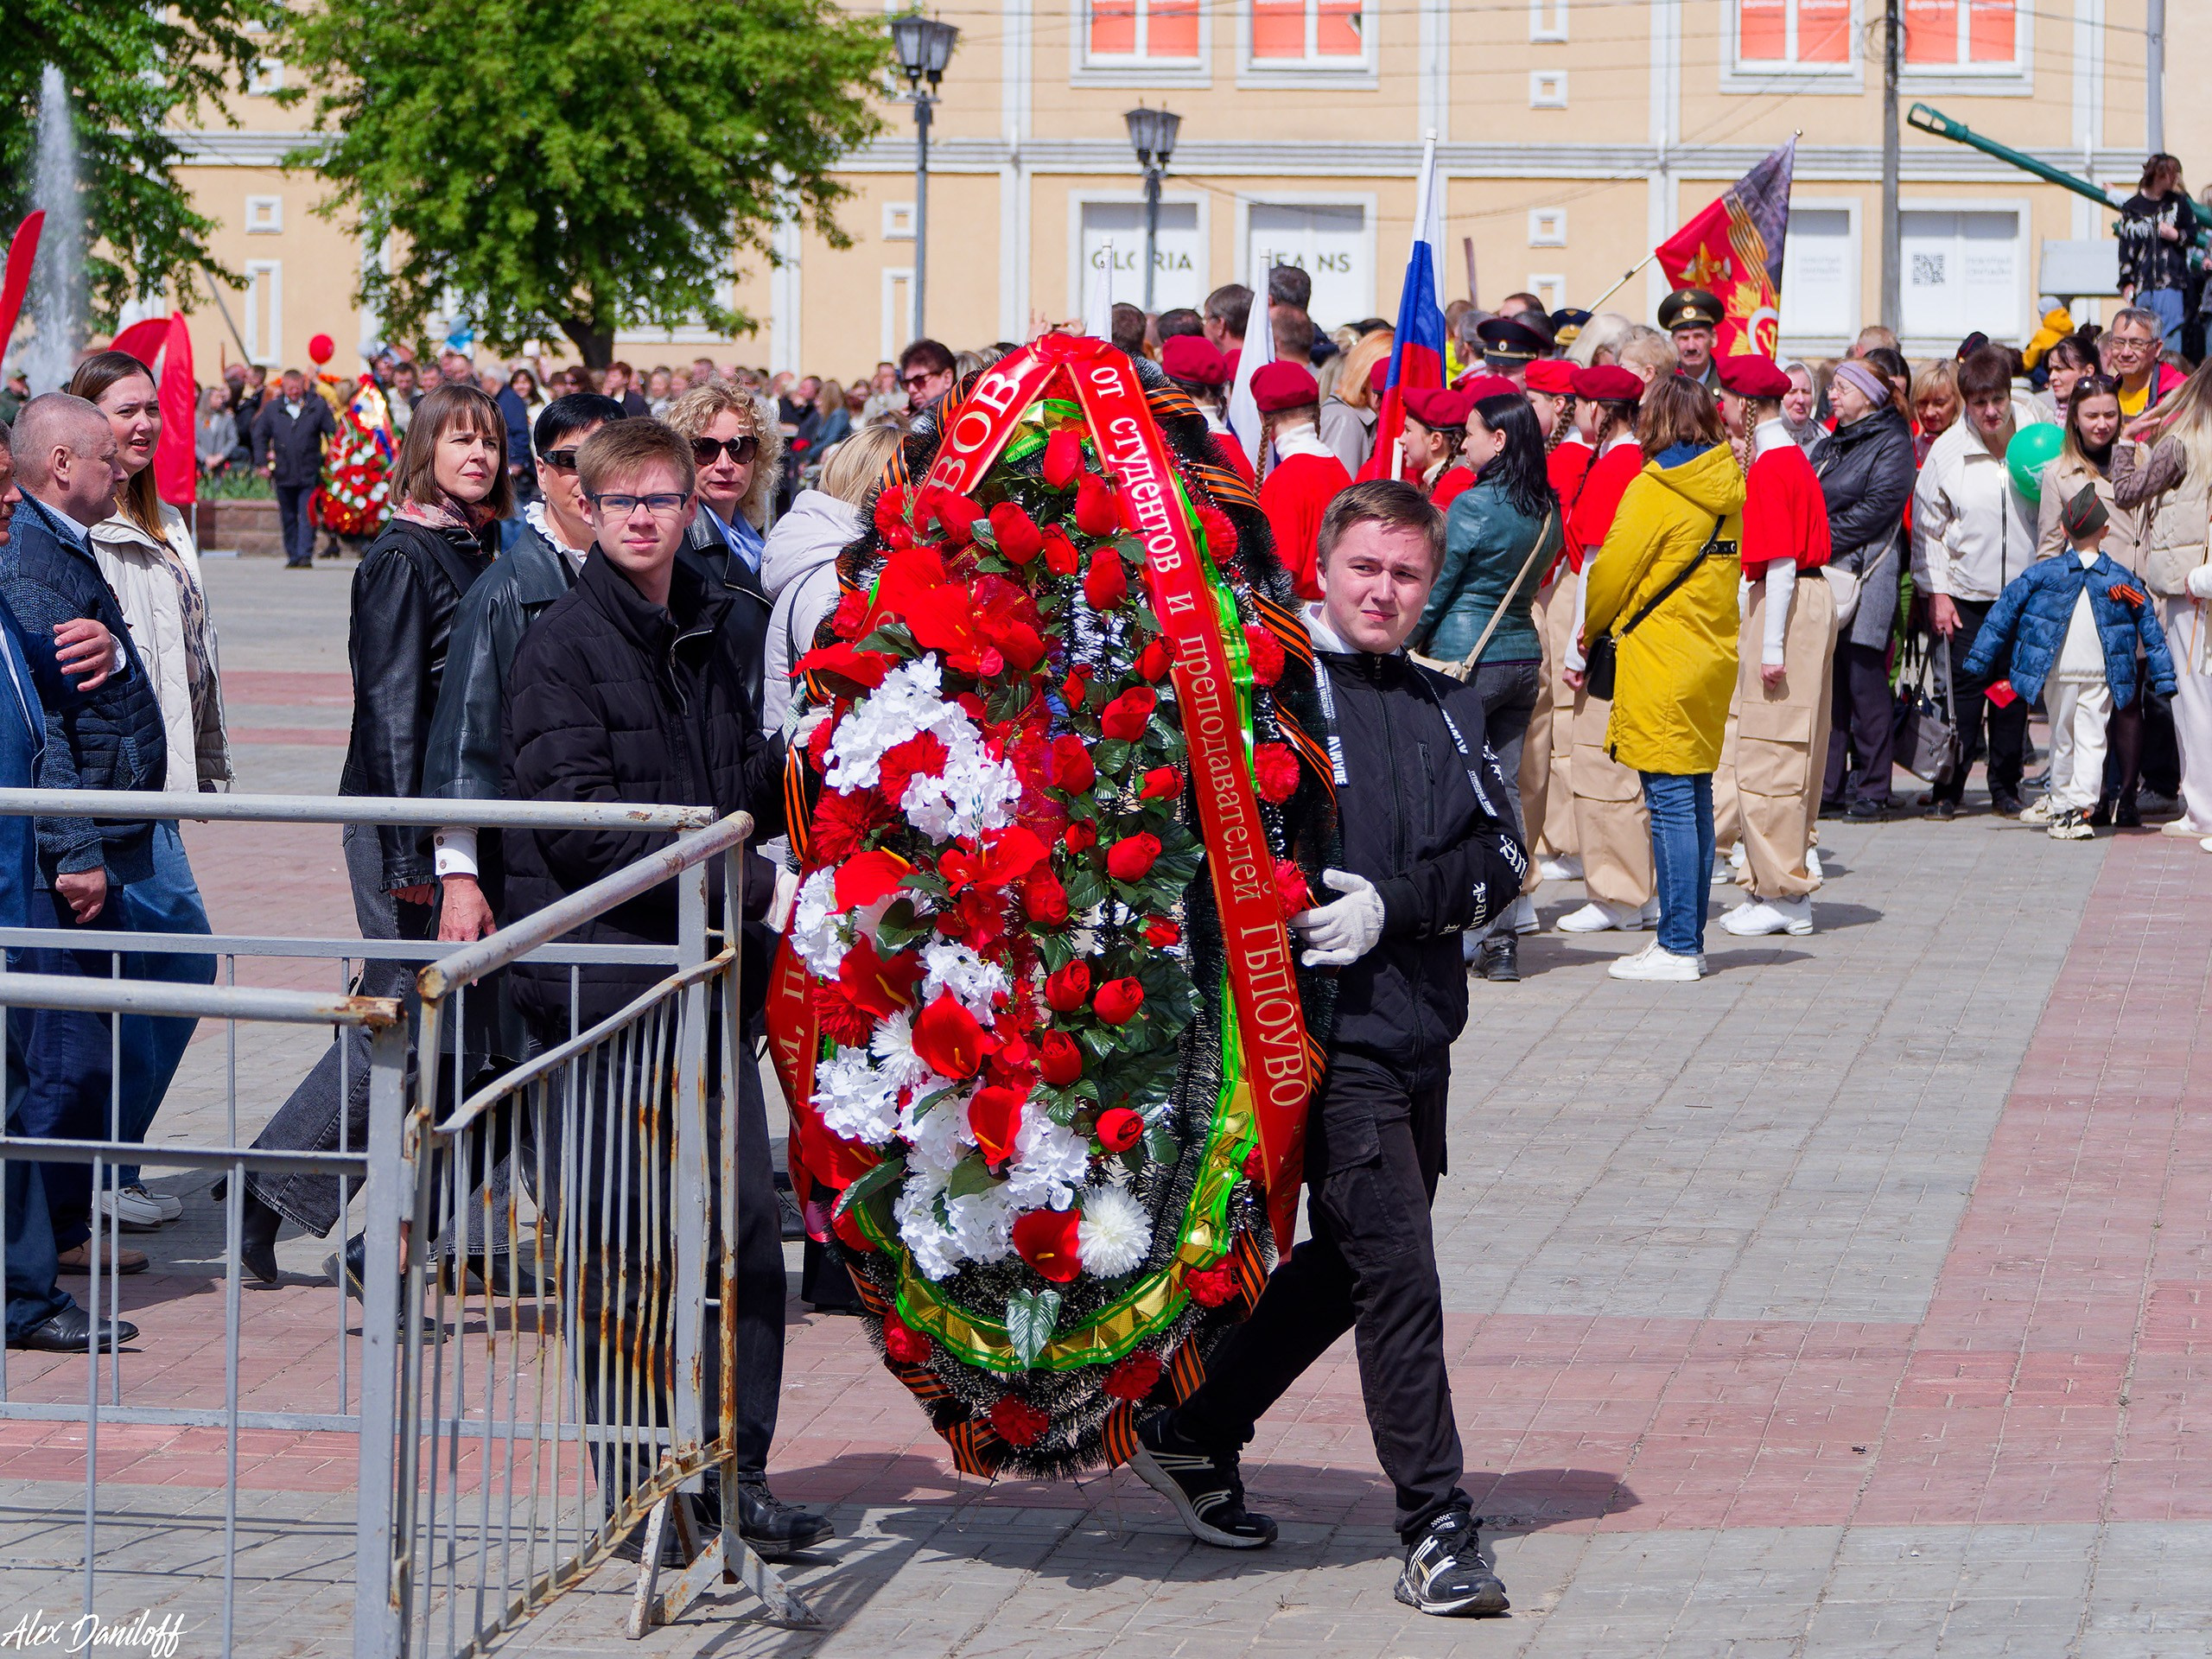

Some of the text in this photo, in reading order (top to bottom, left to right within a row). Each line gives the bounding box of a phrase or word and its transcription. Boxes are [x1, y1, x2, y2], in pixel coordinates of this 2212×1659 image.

[1270, 251, 1351, 273] EANS
[925, 372, 1020, 493] ВОВ
[1109, 416, 1182, 573] студентов
[1166, 591, 1196, 615] и
[1179, 633, 1272, 904] преподавателей
